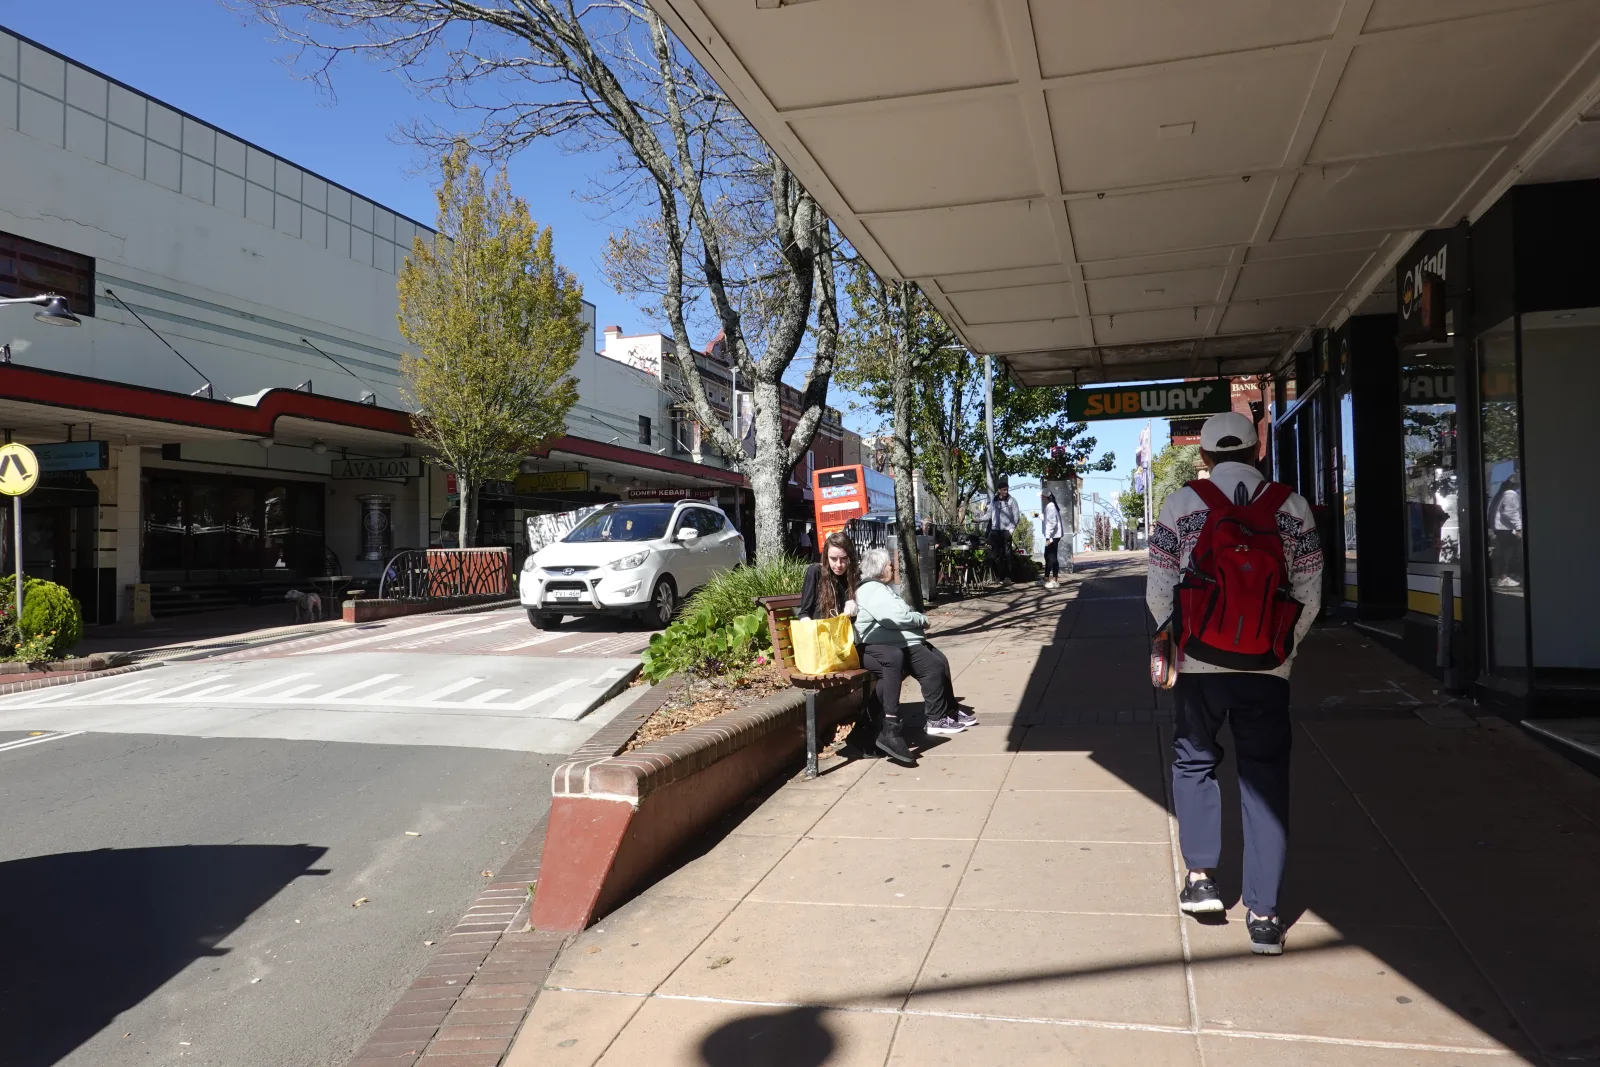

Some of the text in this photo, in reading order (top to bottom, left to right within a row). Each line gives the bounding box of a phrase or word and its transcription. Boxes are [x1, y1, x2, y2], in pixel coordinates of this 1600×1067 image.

[1231, 382, 1258, 392] BANK
[1083, 385, 1213, 416] SUBWAY
[343, 461, 410, 477] AVALON
